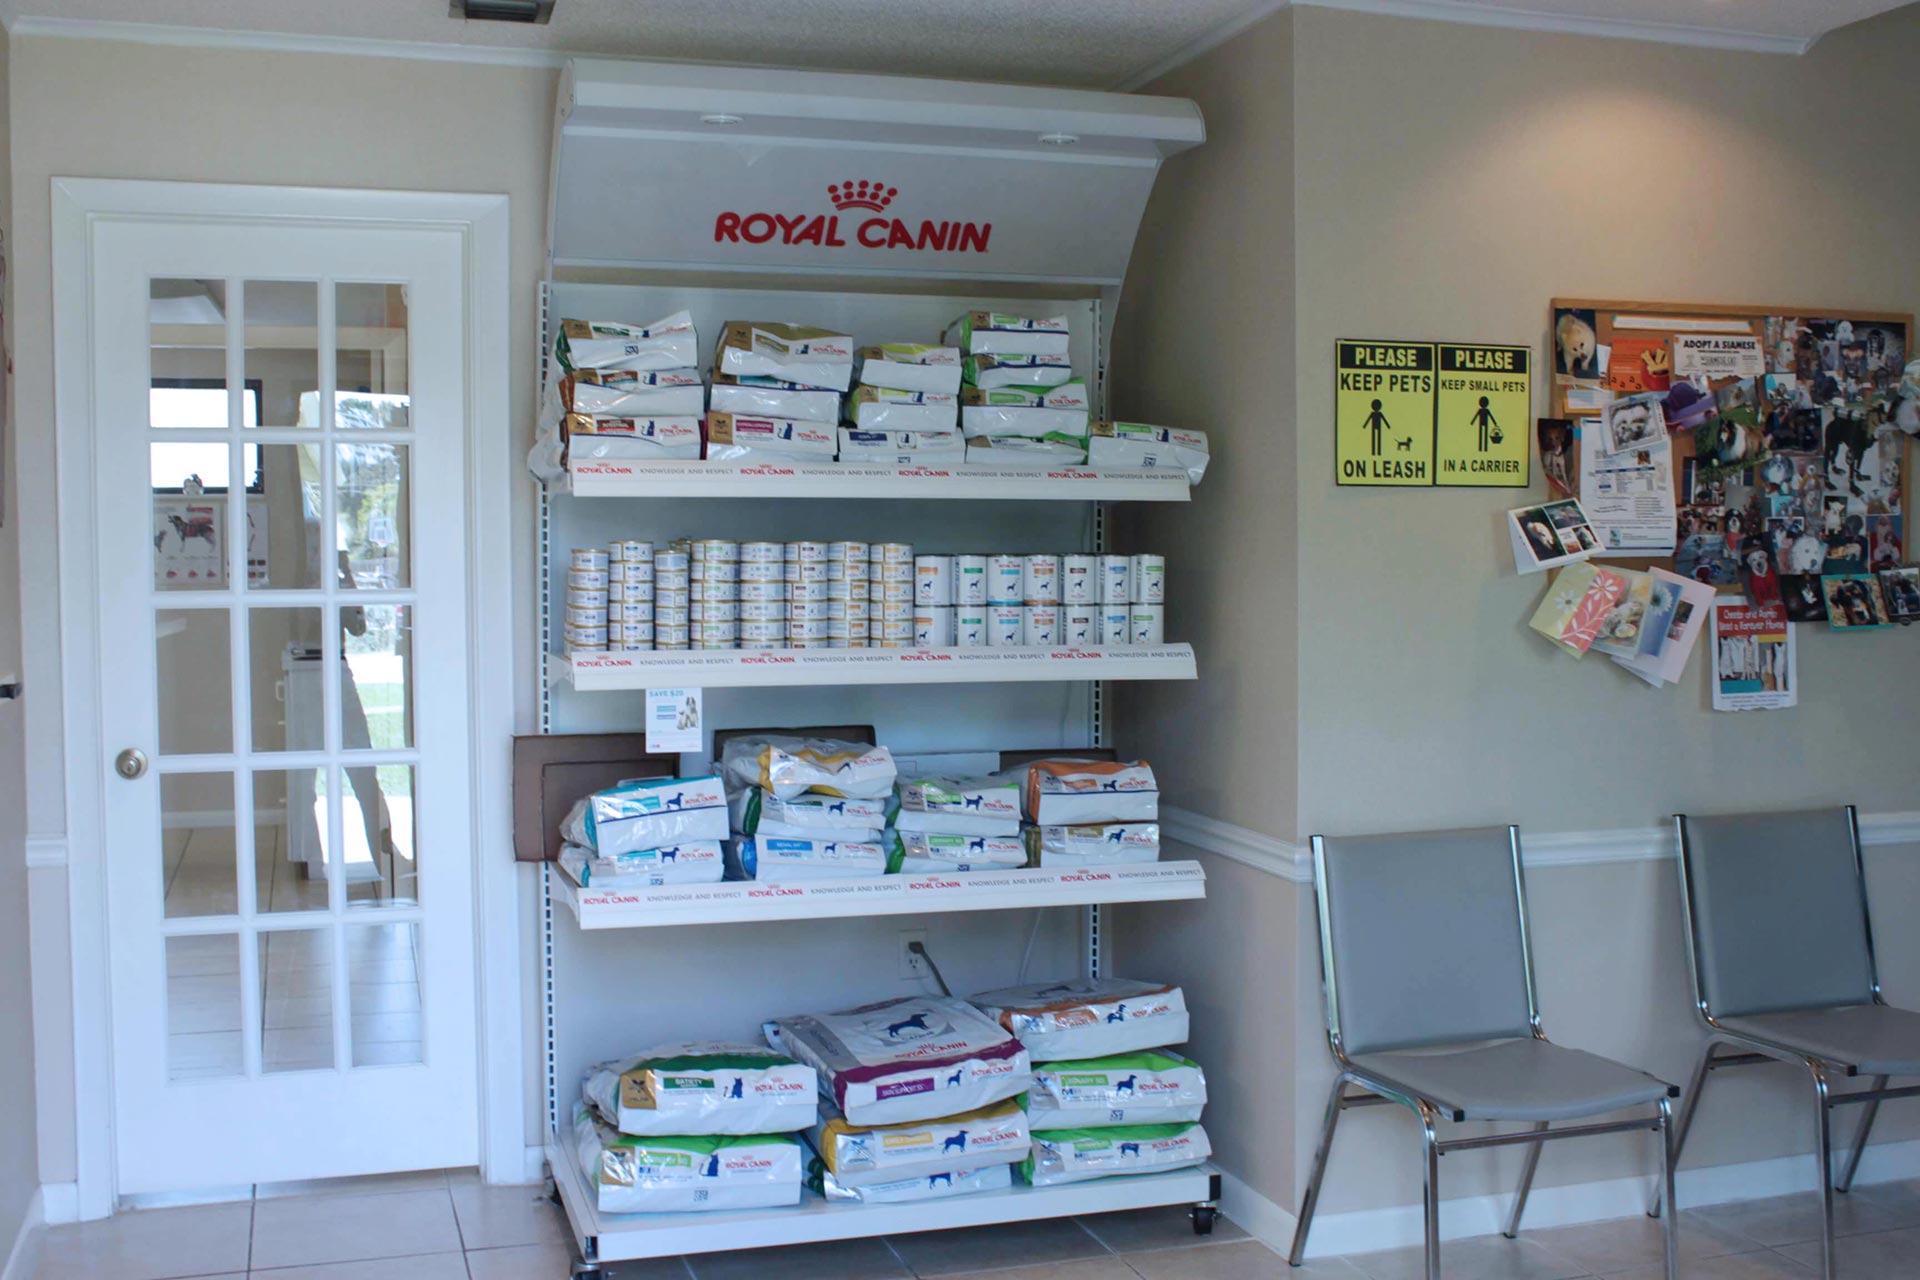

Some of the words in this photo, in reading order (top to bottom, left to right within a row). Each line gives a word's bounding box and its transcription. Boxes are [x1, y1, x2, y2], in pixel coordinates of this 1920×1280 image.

[714, 211, 846, 247] ROYAL
[857, 217, 992, 253] CANIN
[1683, 340, 1712, 349] ADOPT
[1713, 340, 1720, 349] A
[1722, 341, 1756, 350] SIAMESE
[1355, 347, 1417, 367] PLEASE
[1455, 350, 1514, 370] PLEASE
[1340, 373, 1383, 392] KEEP
[1389, 374, 1431, 393] PETS
[1441, 379, 1466, 391] KEEP
[1469, 379, 1500, 392] SMALL
[1502, 381, 1526, 393] PETS
[740, 468, 765, 476] ROYAL
[1343, 460, 1366, 478] ON
[1373, 460, 1426, 479] LEASH
[1444, 459, 1456, 472] IN
[1459, 460, 1468, 472] A
[1470, 459, 1520, 473] CARRIER
[909, 882, 934, 890] ROYAL
[935, 881, 961, 889] CANIN
[776, 889, 803, 897] CANIN
[584, 897, 610, 905] ROYAL
[931, 1041, 968, 1053] CANIN
